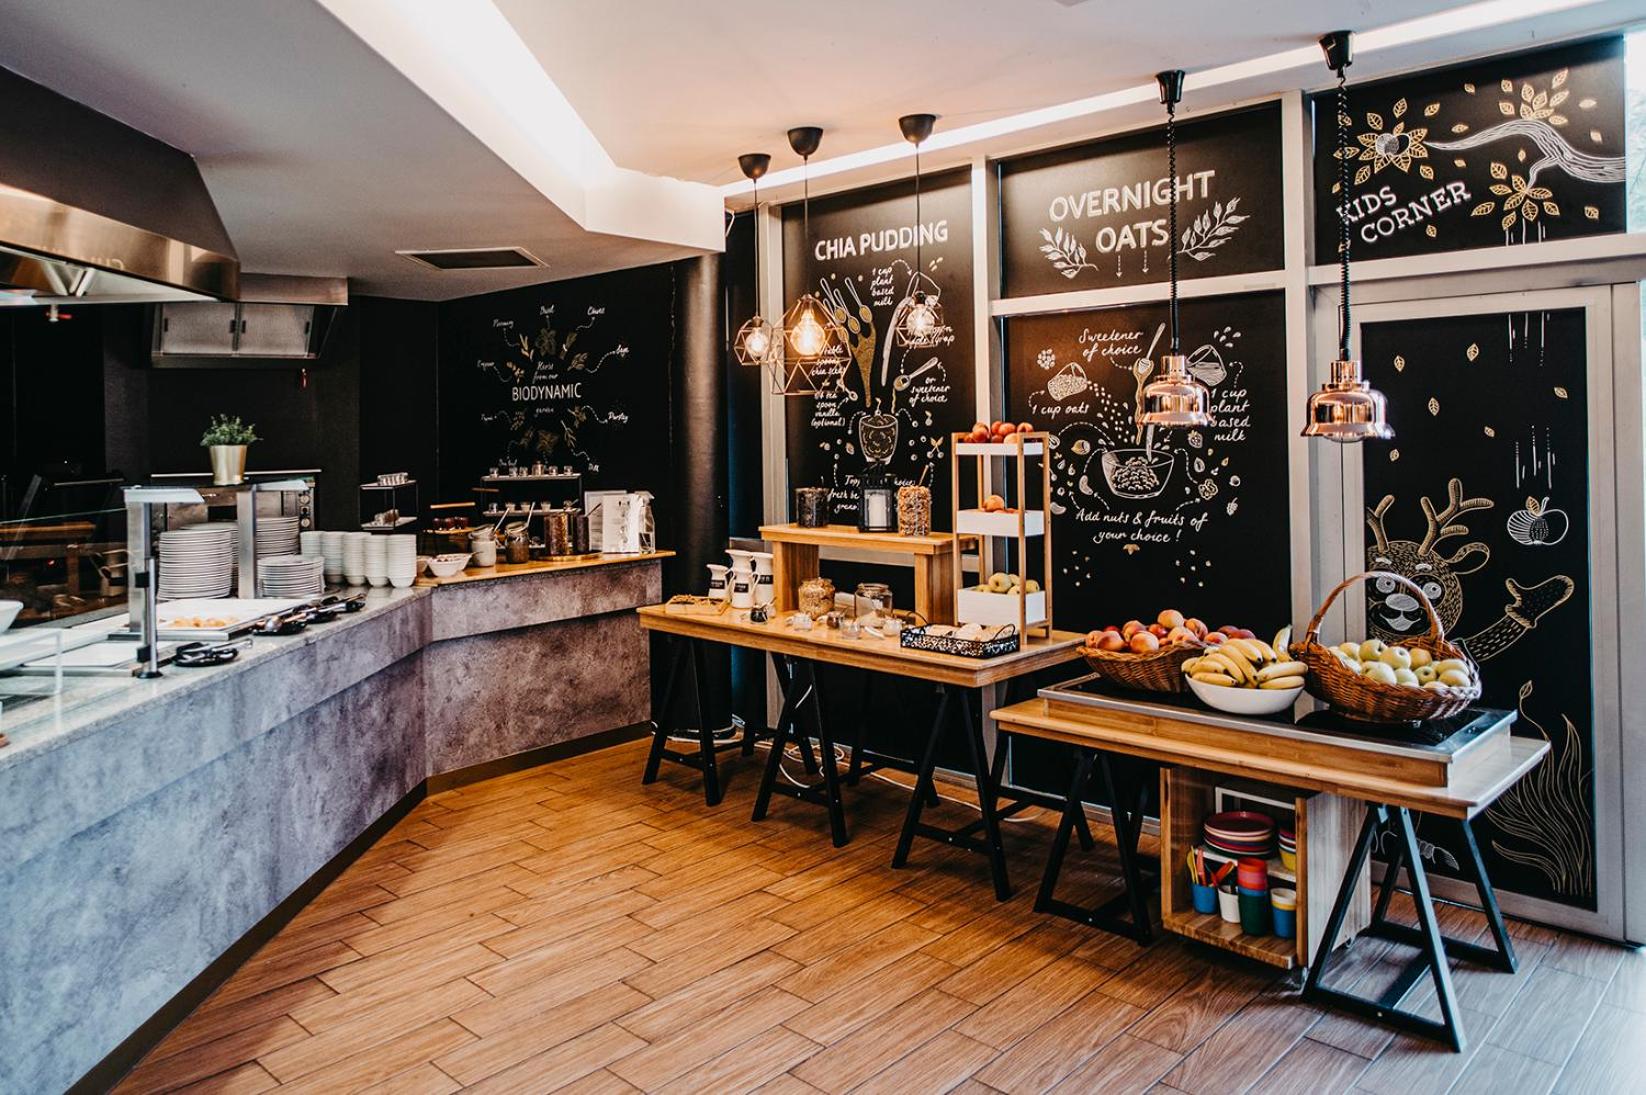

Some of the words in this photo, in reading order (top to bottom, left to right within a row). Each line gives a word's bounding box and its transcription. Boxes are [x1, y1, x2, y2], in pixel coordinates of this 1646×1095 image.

[1050, 169, 1215, 222] OVERNIGHT
[1336, 186, 1397, 225] KIDS
[1360, 181, 1472, 243] CORNER
[814, 236, 857, 261] CHIA
[860, 219, 949, 256] PUDDING
[1095, 218, 1169, 253] OATS
[878, 266, 893, 277] cup
[870, 274, 894, 290] plant
[871, 286, 895, 297] based
[873, 296, 894, 306] milk
[1078, 327, 1144, 344] Sweetener
[1082, 342, 1099, 362] of
[1101, 343, 1142, 357] choice
[925, 376, 937, 385] or
[511, 382, 582, 401] BIODYNAMIC
[911, 385, 951, 394] sweetener
[1211, 388, 1217, 398] 1
[1221, 389, 1247, 403] cup
[908, 393, 920, 408] of
[920, 393, 948, 403] choice
[814, 407, 841, 418] vanilla
[1031, 404, 1038, 415] 1
[1040, 405, 1061, 419] cup
[1064, 401, 1090, 415] oats
[1213, 428, 1247, 442] milk
[1075, 508, 1101, 521] Add
[1103, 511, 1130, 523] nuts
[1132, 511, 1143, 525] &
[1144, 510, 1184, 528] fruits
[1190, 512, 1208, 532] of
[1092, 530, 1127, 544] your
[1130, 528, 1171, 543] choice
